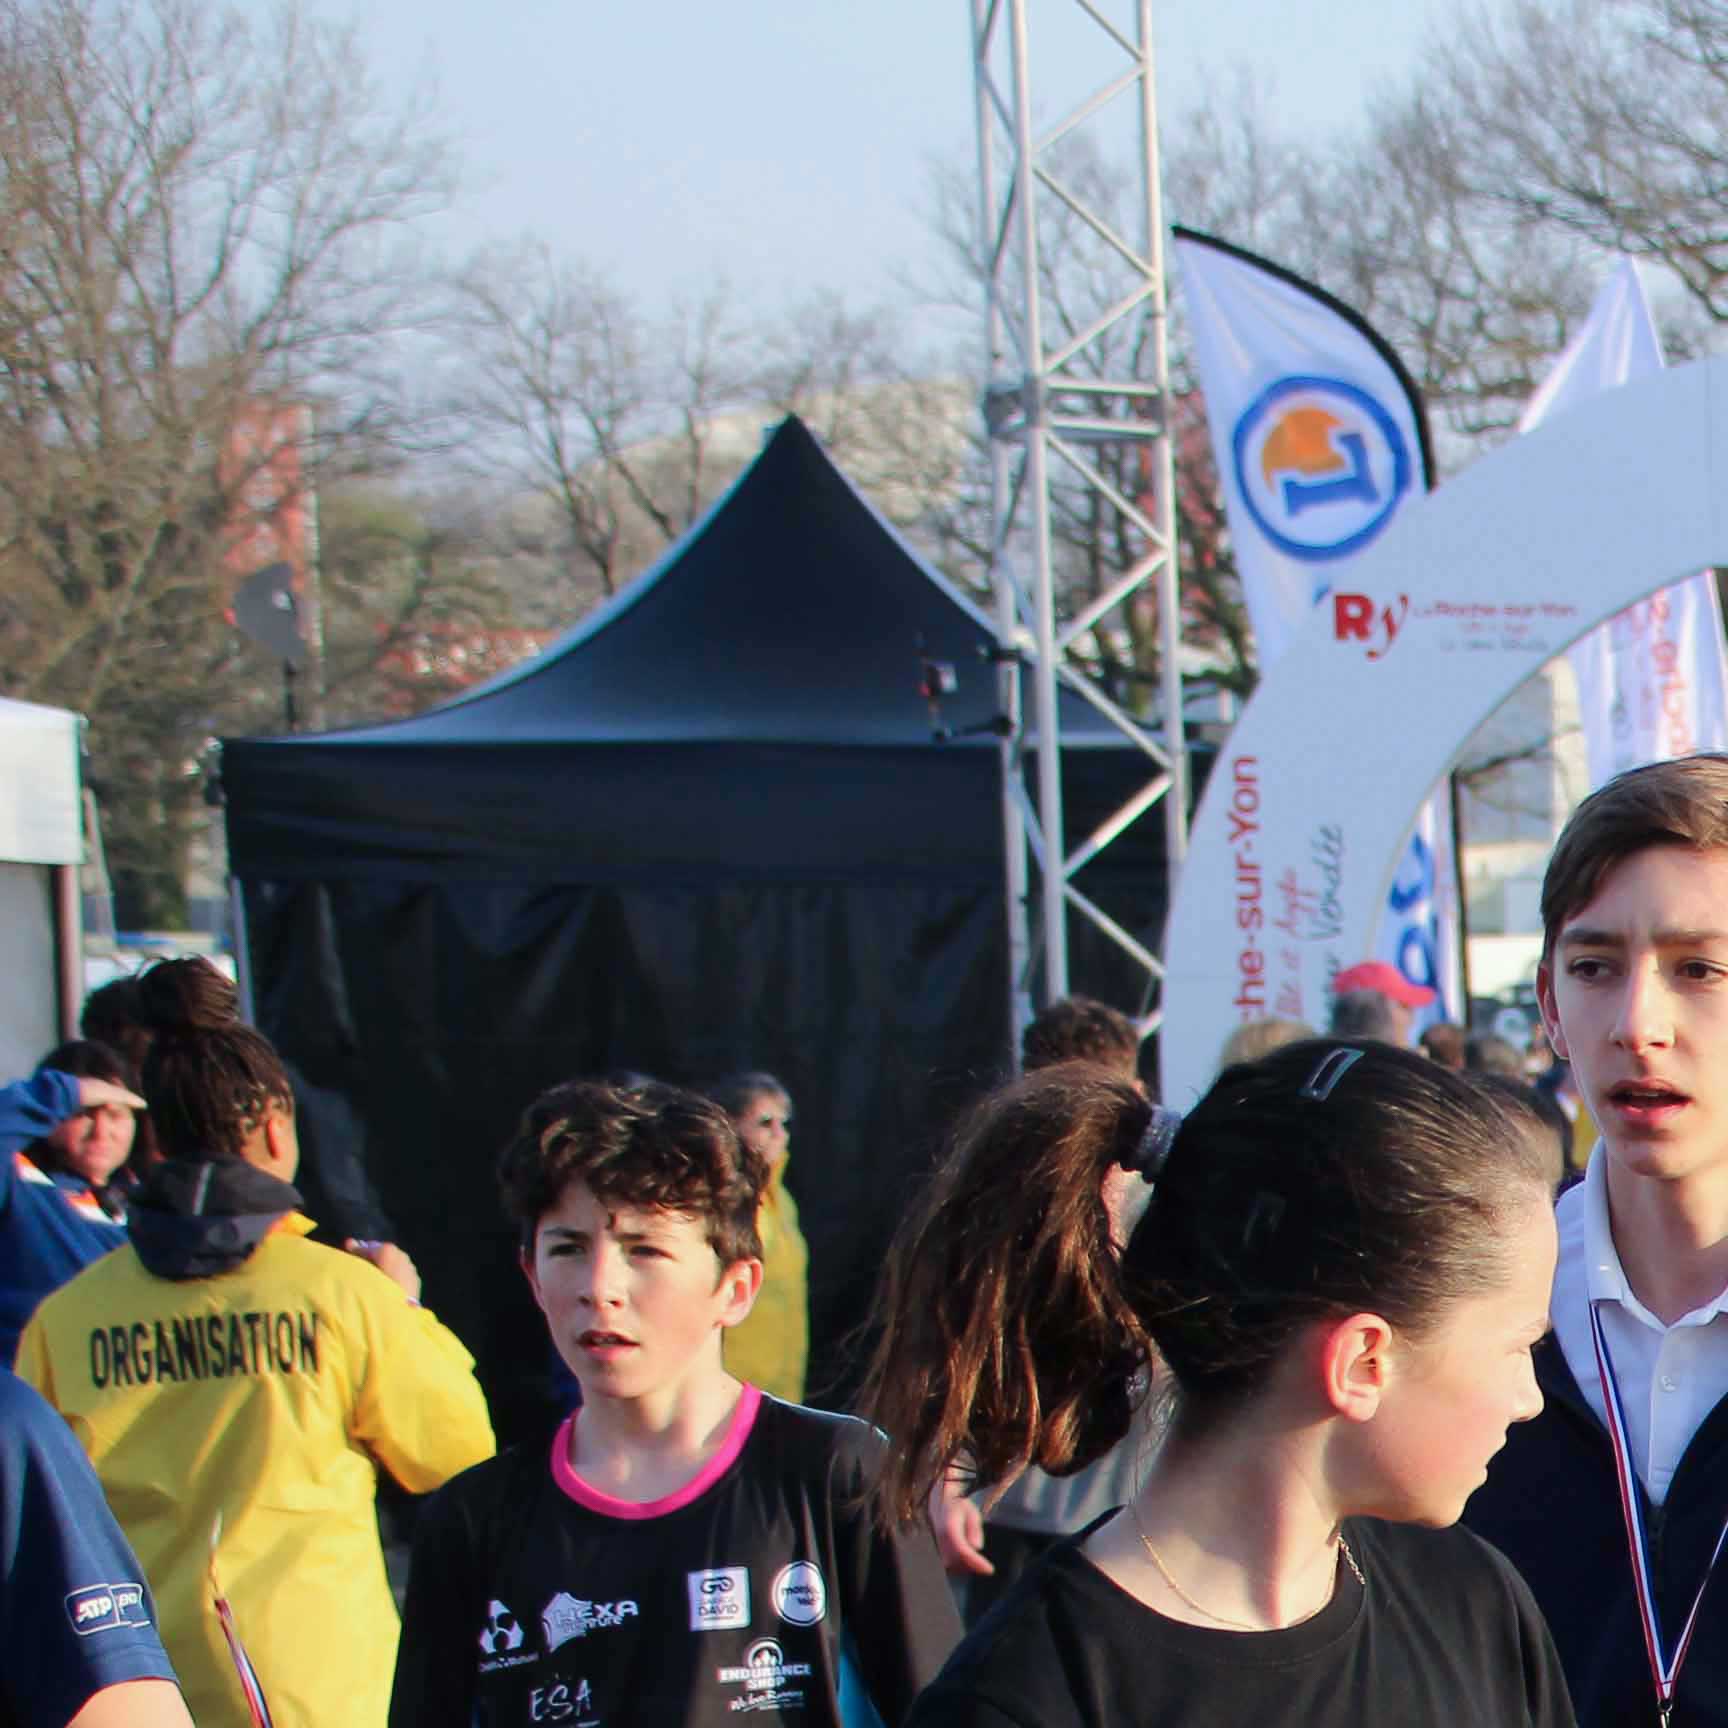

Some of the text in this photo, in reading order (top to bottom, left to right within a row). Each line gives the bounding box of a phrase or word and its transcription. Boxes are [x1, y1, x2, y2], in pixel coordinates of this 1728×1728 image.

[1334, 592, 1409, 661] Ry
[90, 1311, 321, 1390] ORGANISATION
[698, 1604, 739, 1616] DAVID
[717, 1664, 811, 1684] ENDURANCE
[746, 1676, 786, 1691] SHOP
